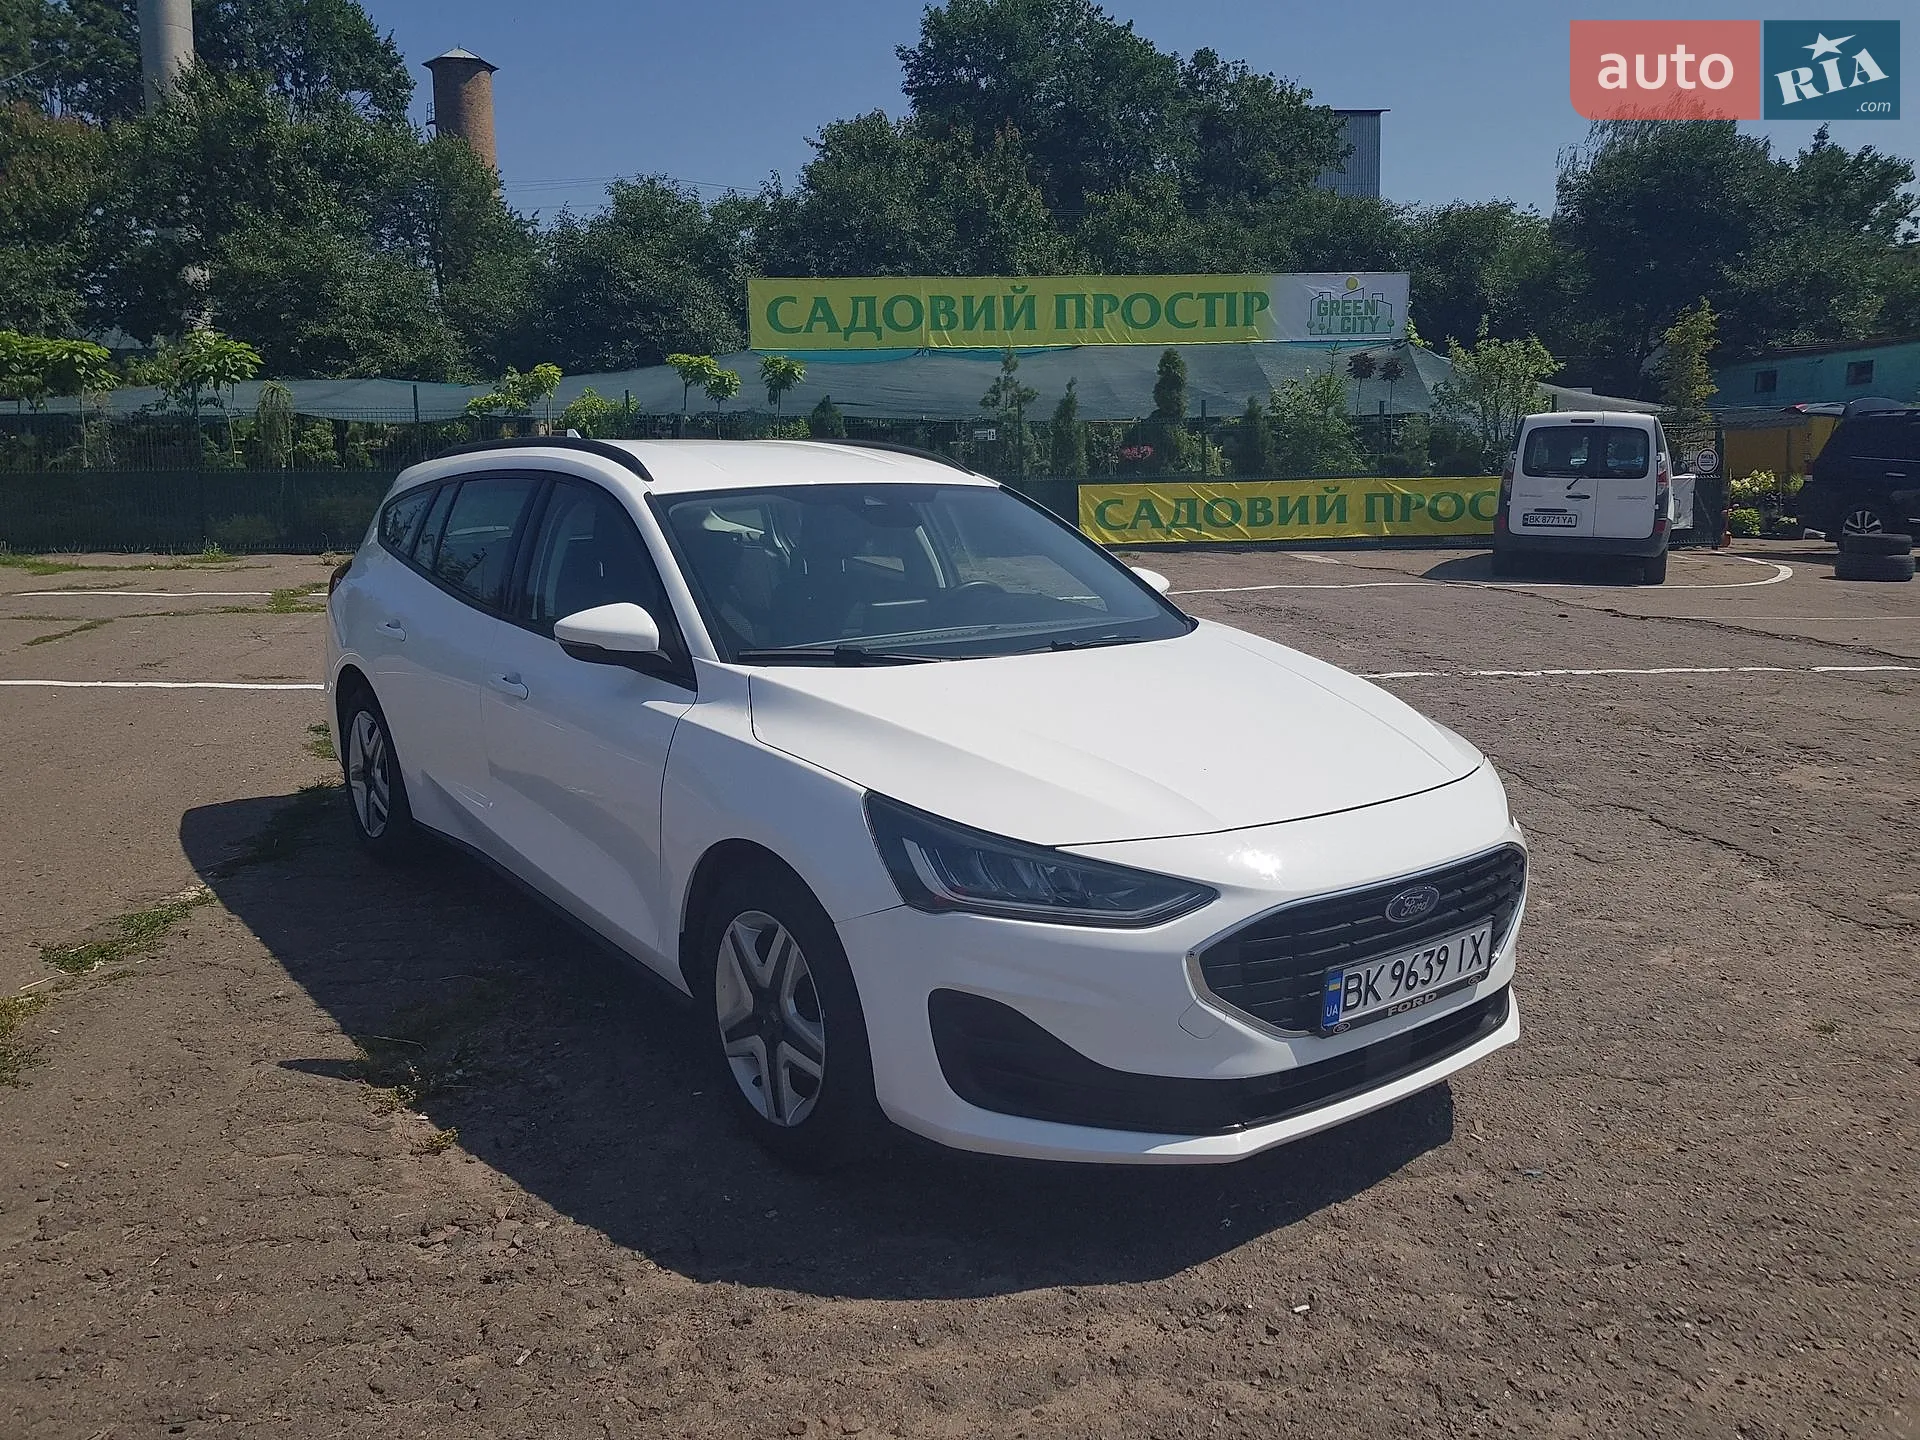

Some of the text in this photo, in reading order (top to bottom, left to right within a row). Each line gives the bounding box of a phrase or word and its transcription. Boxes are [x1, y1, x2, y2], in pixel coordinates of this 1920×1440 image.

[766, 285, 1271, 342] САДОВИЙ ПРОСТІР
[1317, 300, 1376, 316] GREEN
[1341, 316, 1380, 333] CITY
[1094, 486, 1348, 535] САДОВИЙ
[1401, 895, 1431, 916] Ford
[1341, 930, 1486, 1013] BK 9639 IX
[1326, 1006, 1339, 1018] UA
[1387, 992, 1437, 1017] FORD
